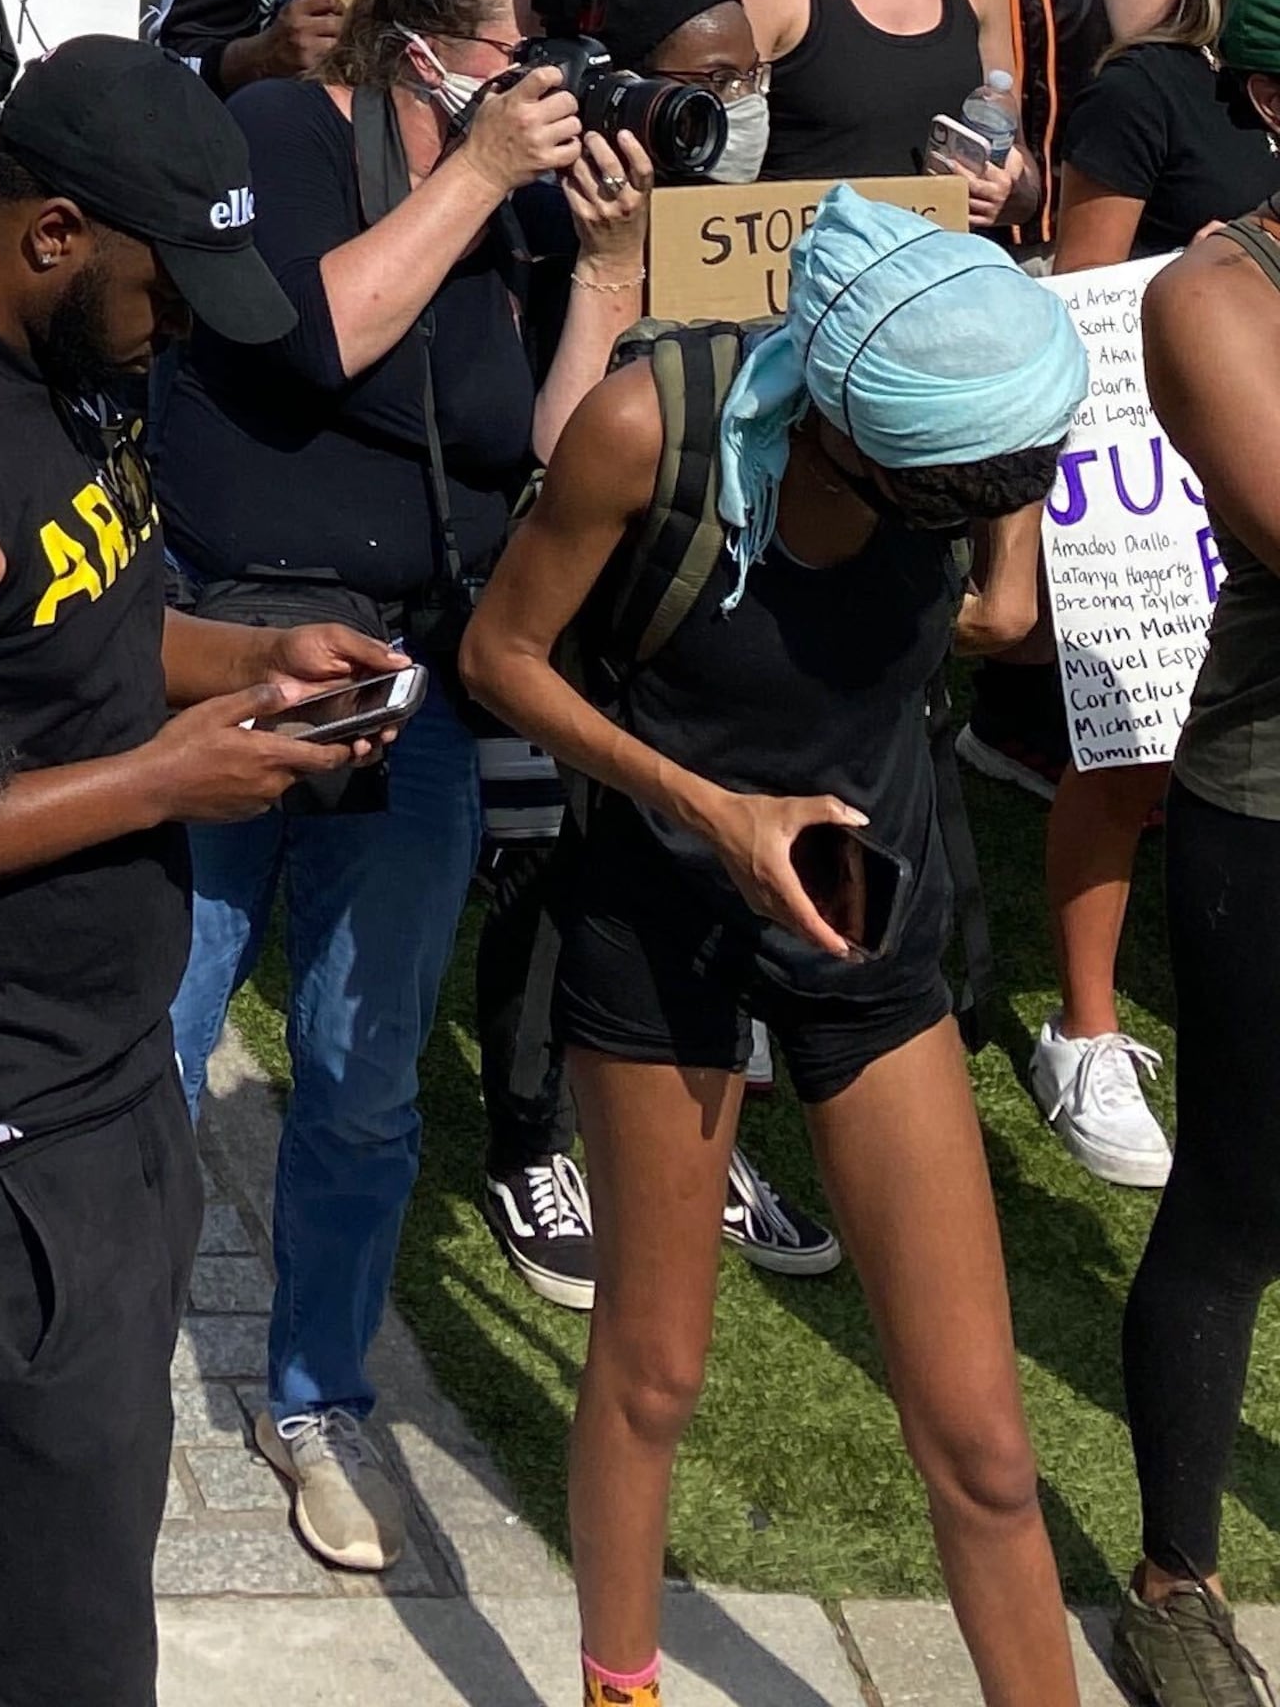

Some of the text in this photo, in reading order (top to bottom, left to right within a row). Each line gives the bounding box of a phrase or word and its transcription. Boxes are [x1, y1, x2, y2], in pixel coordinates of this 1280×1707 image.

[1052, 535, 1116, 557] Amadou
[1052, 567, 1118, 589] LaTanya
[1056, 592, 1134, 612] Breonna
[1061, 627, 1131, 652] Kevin
[1064, 650, 1147, 687] Miguel
[1071, 681, 1185, 712] Cornelius
[1075, 709, 1162, 742] Michael
[1078, 736, 1170, 767] Dominic
